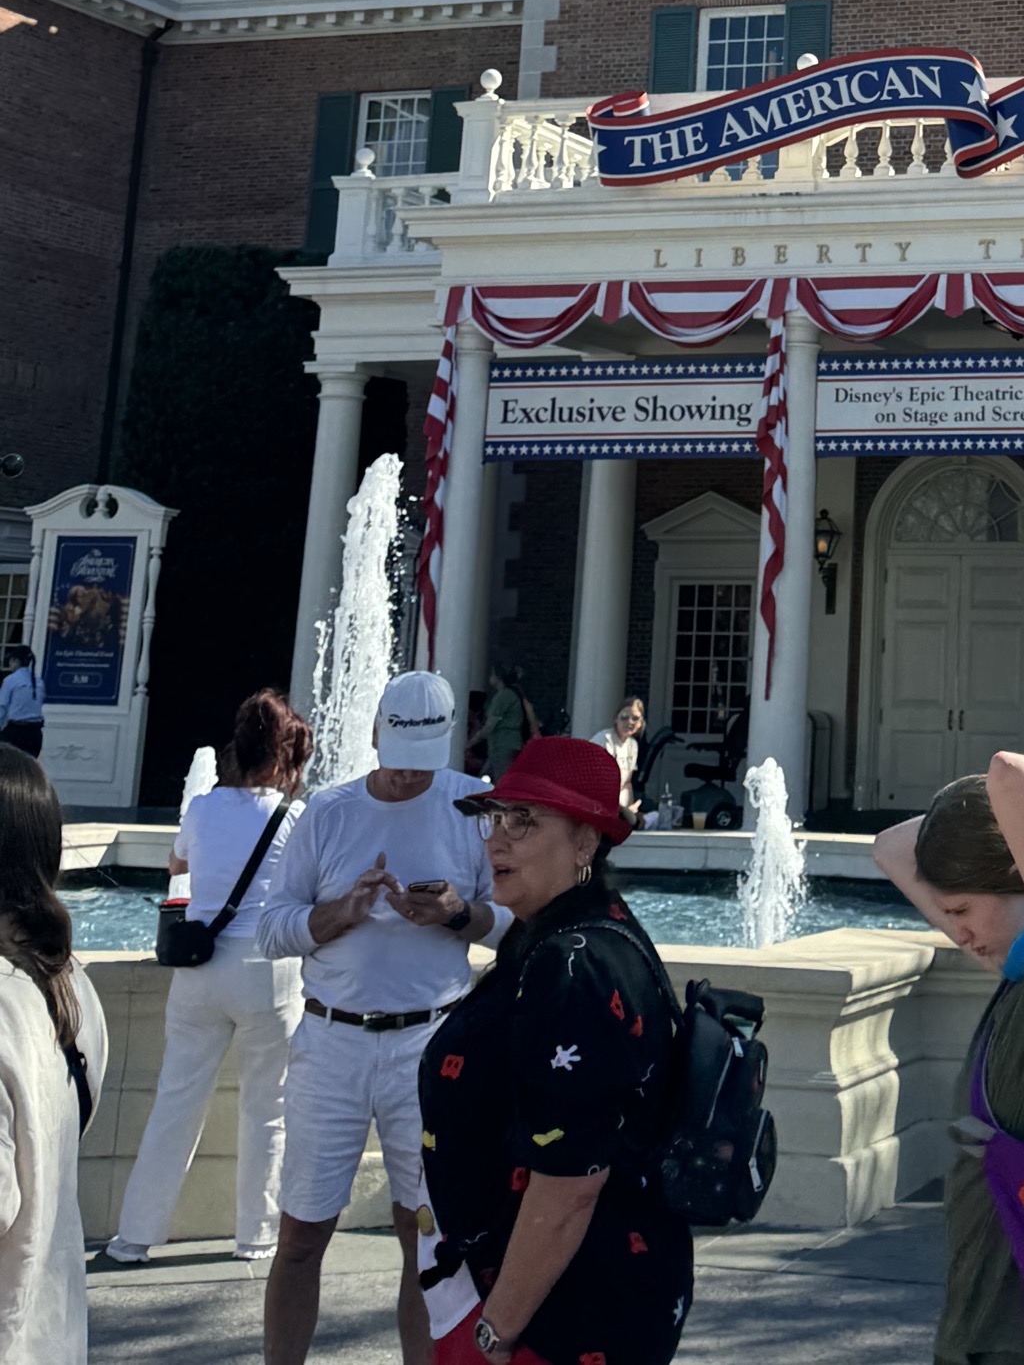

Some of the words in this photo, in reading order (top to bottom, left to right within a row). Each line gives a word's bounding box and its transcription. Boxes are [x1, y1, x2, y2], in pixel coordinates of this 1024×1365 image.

[624, 122, 709, 168] THE
[719, 66, 942, 147] AMERICAN
[653, 242, 912, 268] LIBERTY
[834, 386, 903, 405] Disney's
[909, 386, 946, 405] Epic
[500, 397, 626, 424] Exclusive
[634, 395, 753, 427] Showing
[875, 411, 896, 423] on
[902, 407, 948, 425] Stage
[954, 407, 985, 422] and
